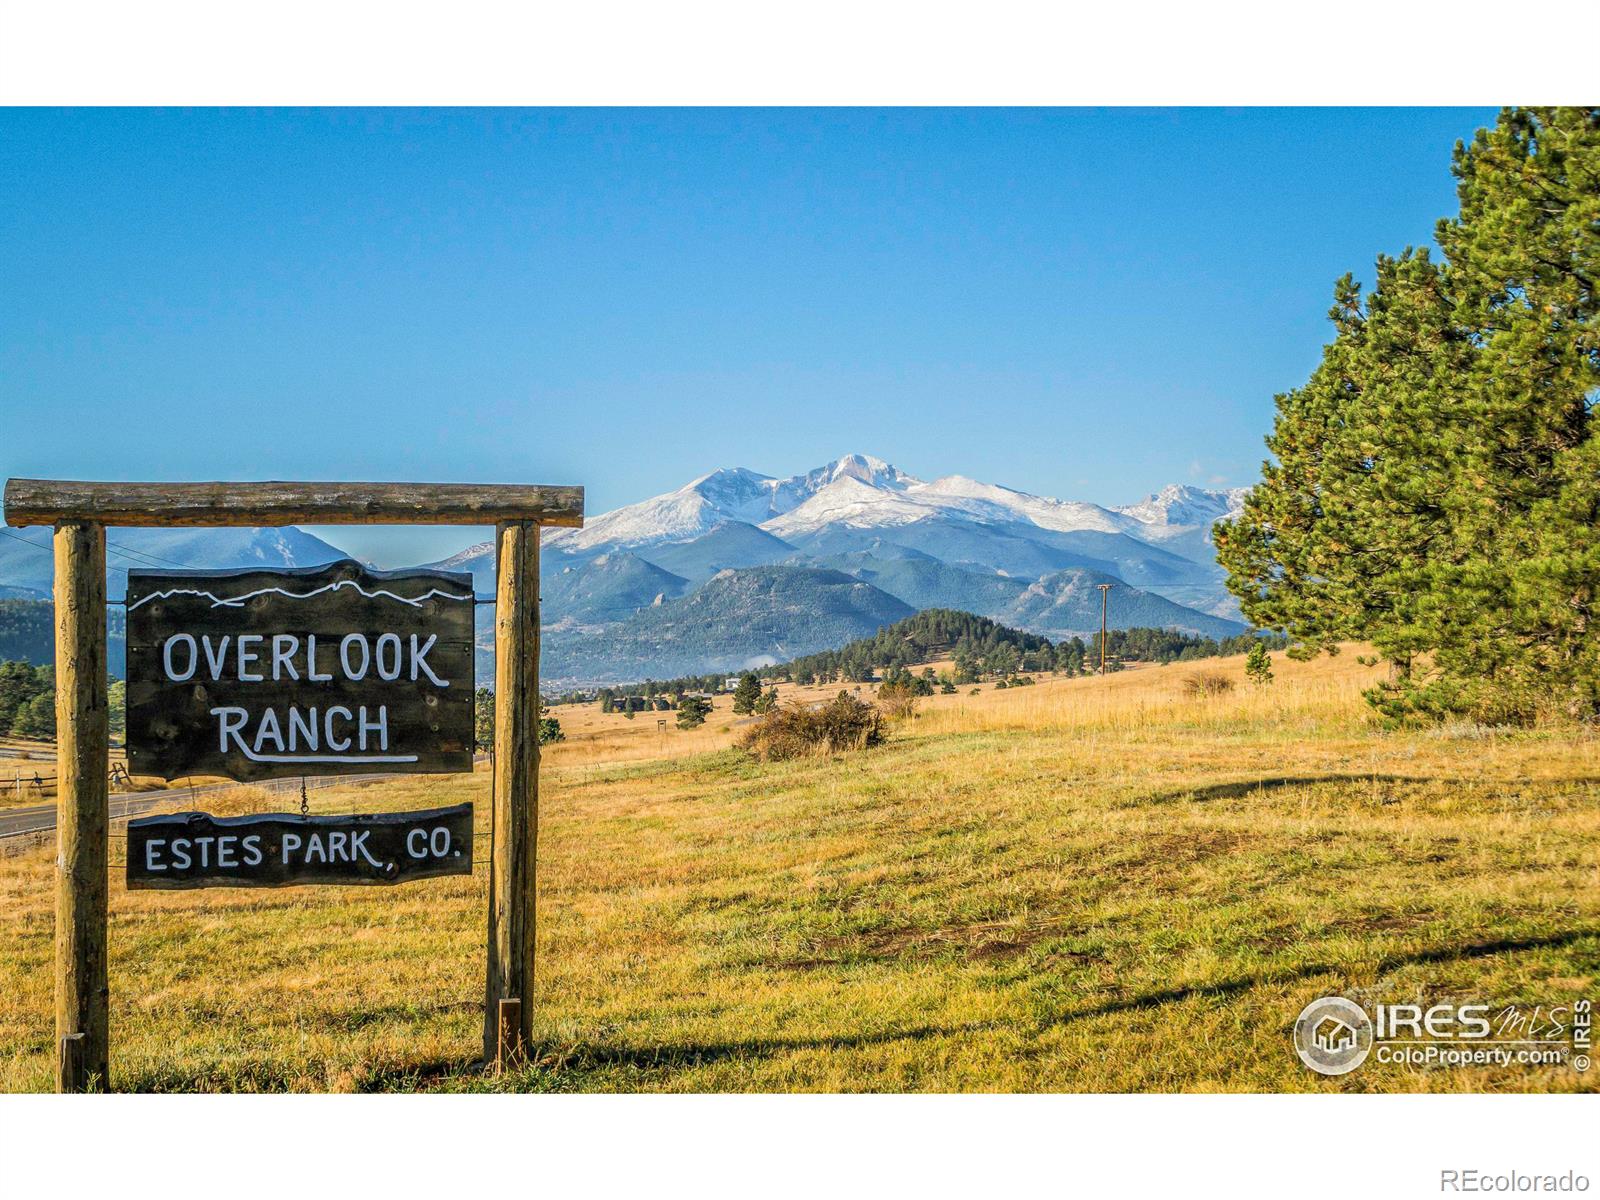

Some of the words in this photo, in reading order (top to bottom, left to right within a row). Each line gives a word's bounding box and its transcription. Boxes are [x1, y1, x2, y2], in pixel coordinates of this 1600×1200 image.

[163, 633, 449, 686] OVERLOOK
[210, 705, 418, 763] RANCH
[146, 835, 262, 870] ESTES
[282, 830, 393, 871] PARK,
[406, 827, 461, 858] CO.
